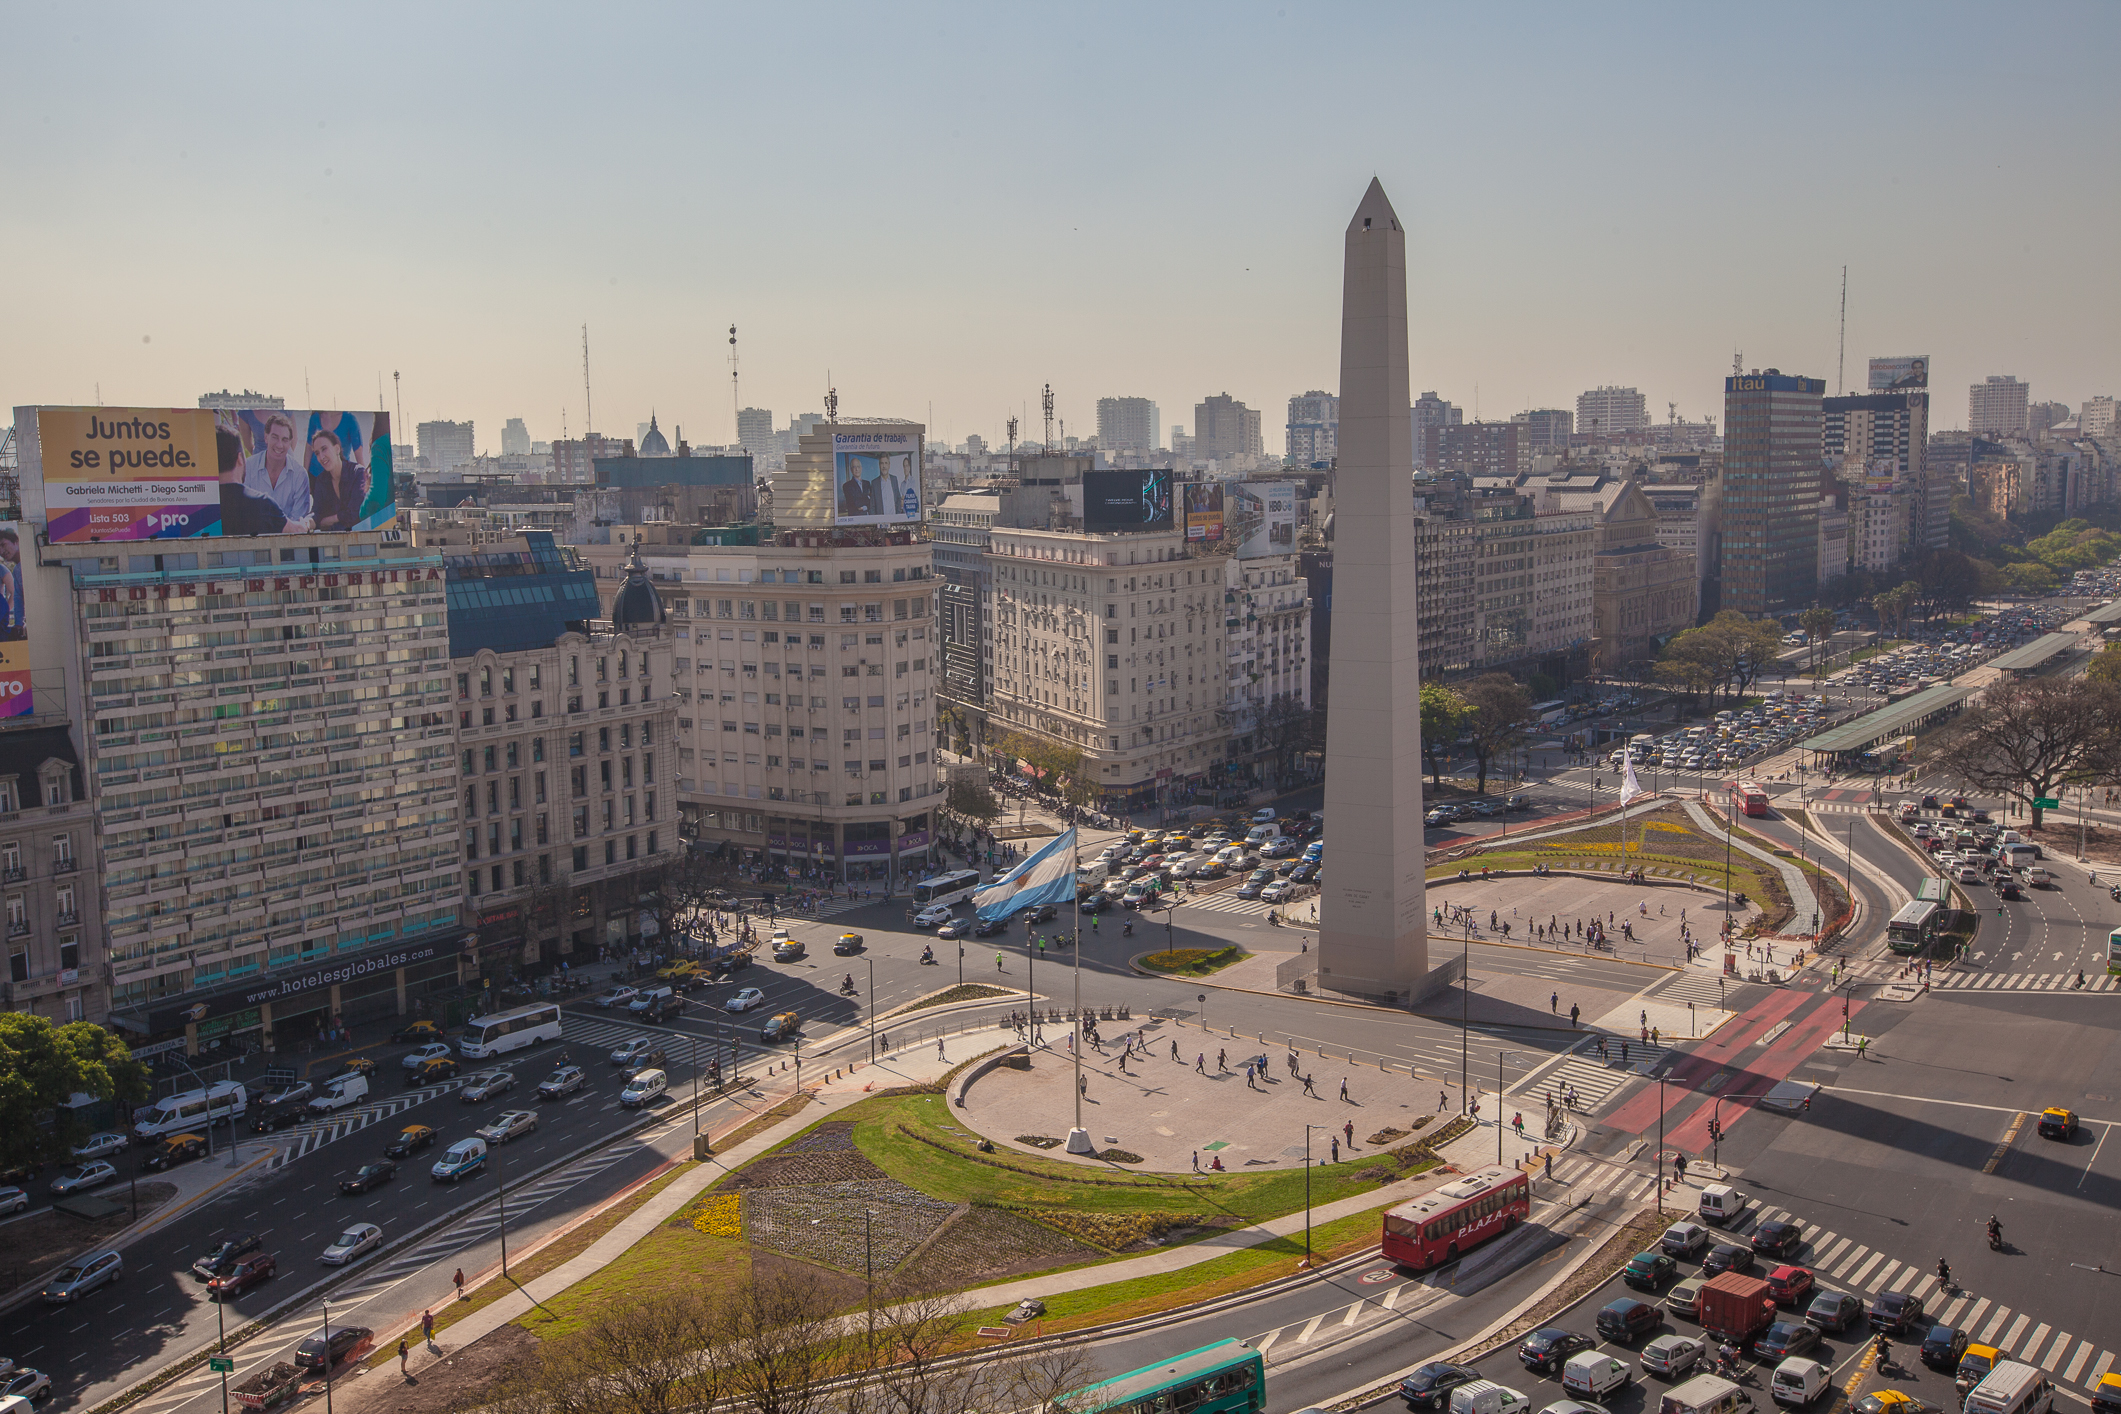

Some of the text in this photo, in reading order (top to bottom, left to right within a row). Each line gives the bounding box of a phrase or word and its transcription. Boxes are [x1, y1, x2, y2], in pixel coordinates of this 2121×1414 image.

[1732, 377, 1765, 390] Itaú
[86, 415, 171, 440] Juntos
[836, 433, 908, 444] Garantía de trabajo.
[70, 443, 196, 475] se puede.
[66, 484, 106, 496] Gabriela
[108, 484, 142, 494] Michetti
[152, 484, 176, 496] Diego
[178, 484, 206, 493] Santilli
[1269, 500, 1282, 512] HBO
[90, 514, 130, 523] Lista 503
[161, 514, 189, 532] pro
[101, 568, 440, 602] HOTEL REPUBLICA
[246, 947, 434, 1003] www.hotelesglobales.com
[245, 1010, 258, 1021] Spa
[1364, 1270, 1393, 1282] 20
